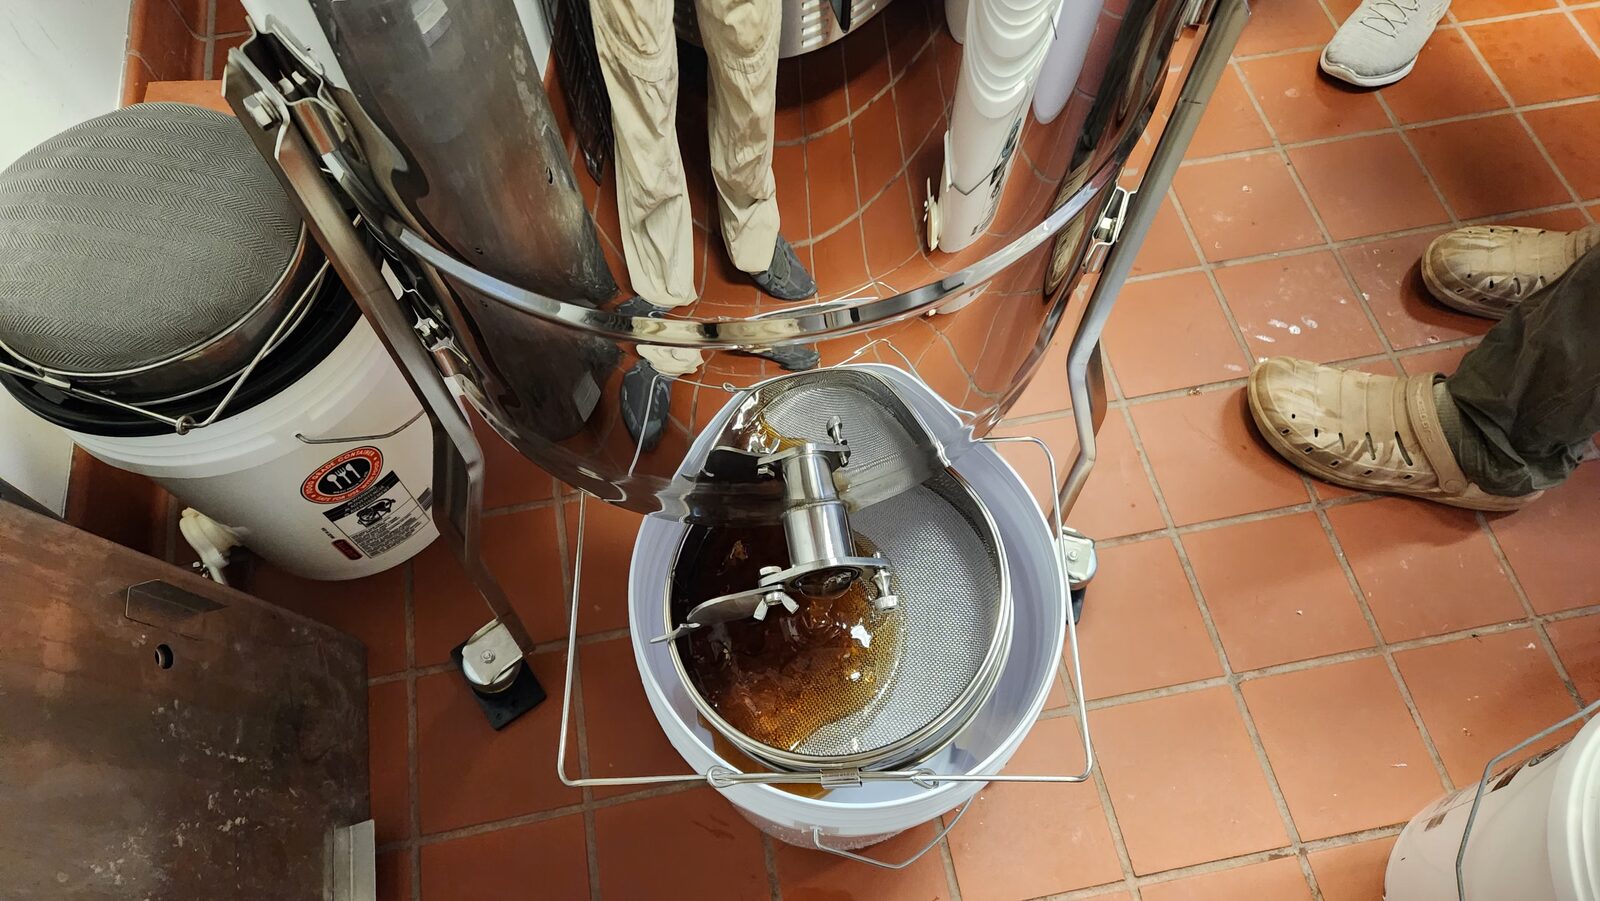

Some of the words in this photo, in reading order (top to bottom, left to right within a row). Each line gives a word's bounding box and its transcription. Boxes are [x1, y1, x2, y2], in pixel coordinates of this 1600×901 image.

[305, 479, 314, 495] FOOD
[312, 461, 336, 480] GRADE
[337, 448, 375, 463] CONTAINER
[347, 489, 360, 497] USE
